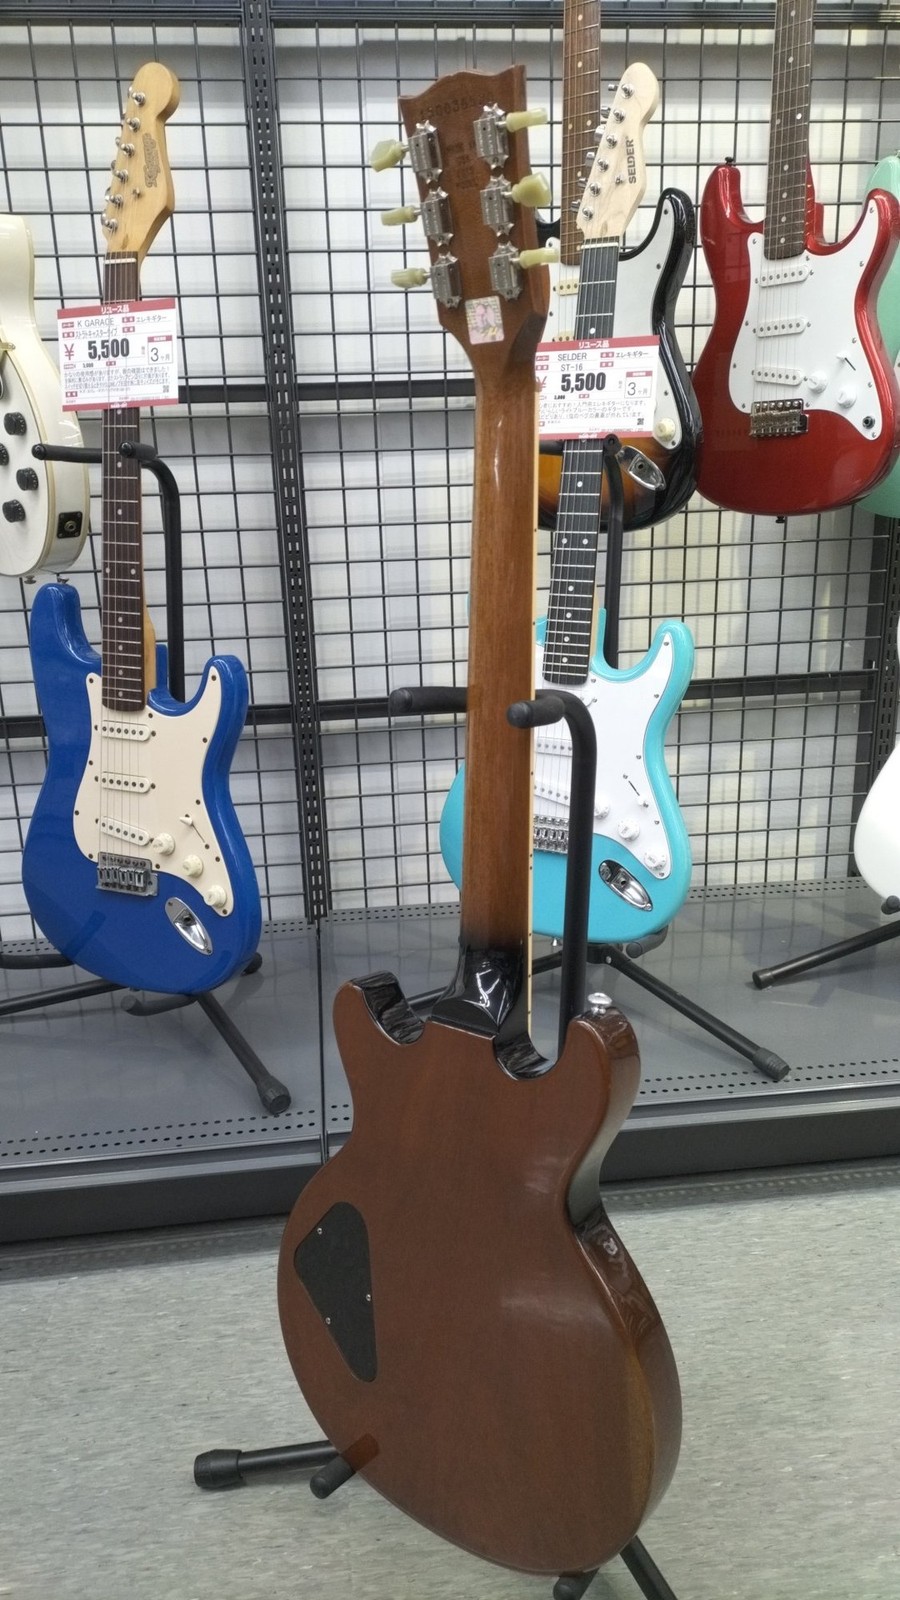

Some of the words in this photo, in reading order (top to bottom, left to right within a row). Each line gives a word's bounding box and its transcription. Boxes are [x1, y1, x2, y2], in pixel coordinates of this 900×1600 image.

[625, 139, 637, 184] SELDER
[101, 304, 130, 315] リユース品
[77, 320, 83, 328] K
[84, 317, 115, 328] GARAGE
[136, 314, 167, 323] エレキギター
[88, 338, 130, 361] 5,500
[578, 340, 610, 349] リユース品
[557, 352, 588, 361] SELDER
[615, 350, 649, 358] エレキギター
[560, 363, 584, 372] ST-16
[561, 372, 607, 394] 5,500
